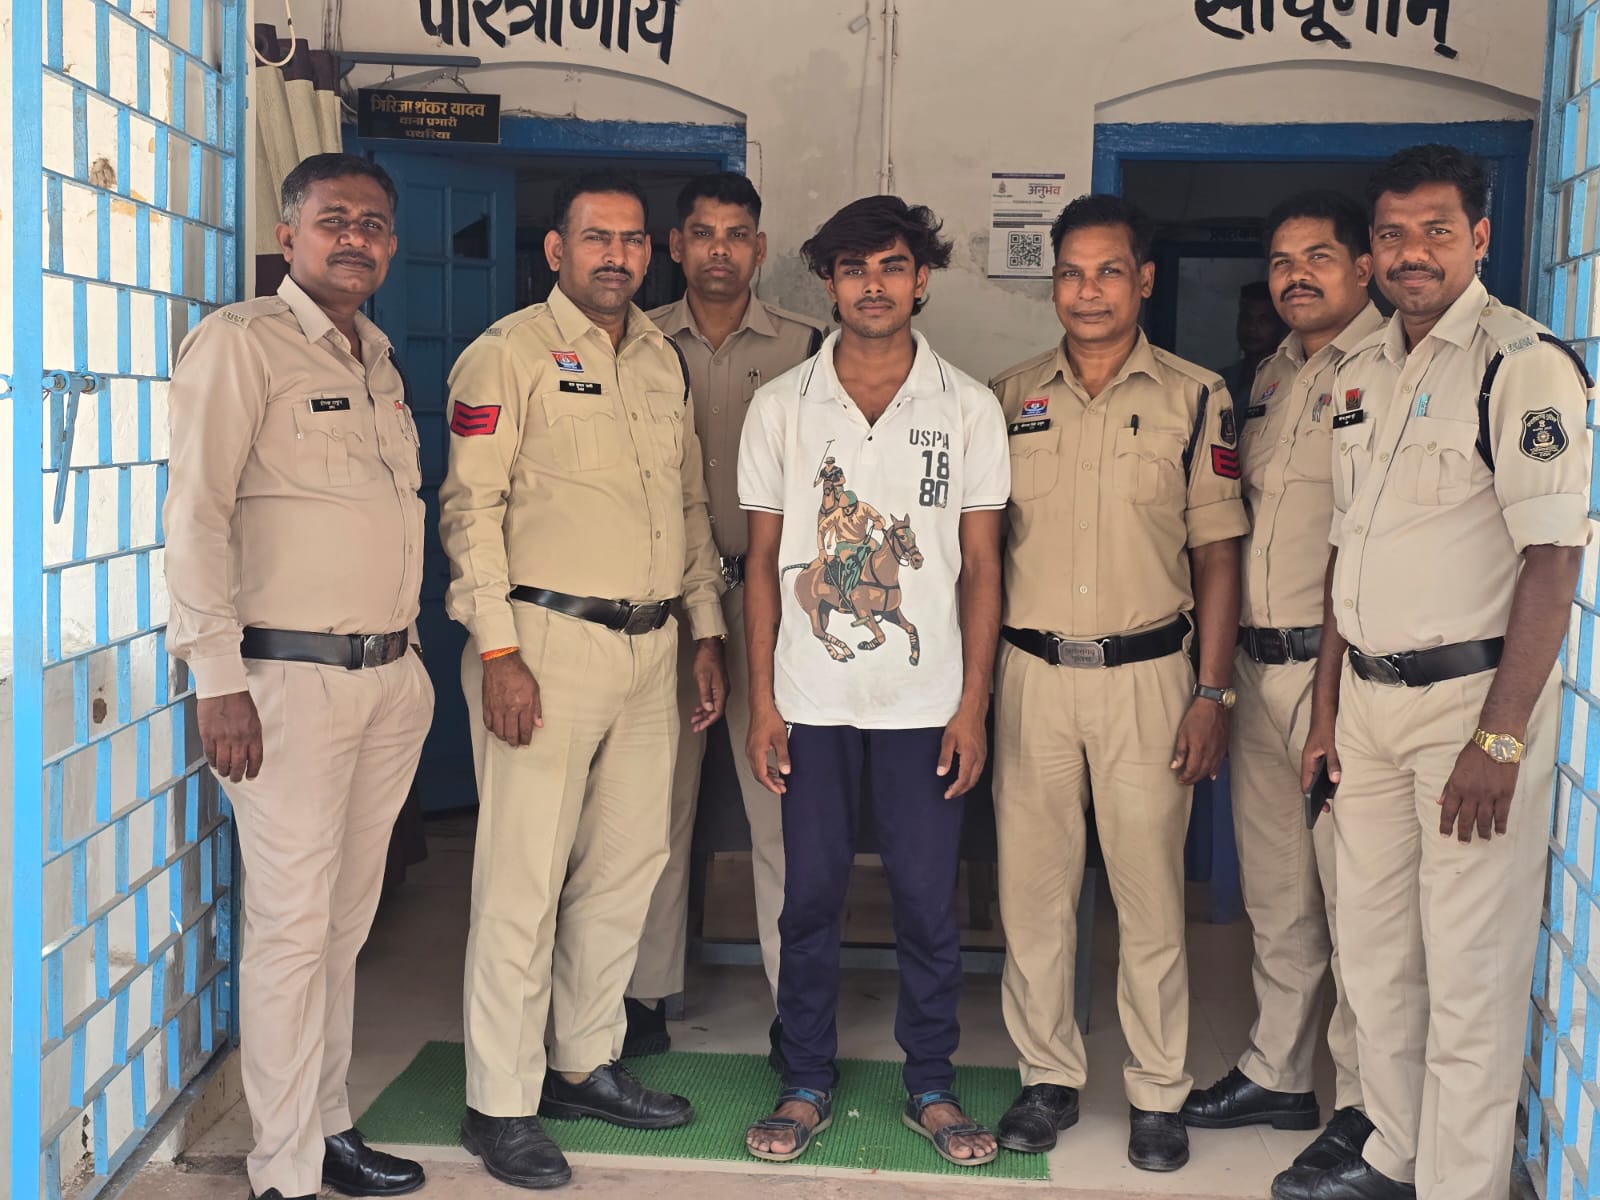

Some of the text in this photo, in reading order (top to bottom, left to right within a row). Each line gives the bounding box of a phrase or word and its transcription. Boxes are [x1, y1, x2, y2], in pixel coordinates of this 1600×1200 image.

[370, 94, 486, 118] गिरिजा शंकर यादव
[1027, 184, 1062, 199] अनुभव
[909, 428, 950, 450] USPA
[921, 450, 950, 480] 18
[919, 478, 949, 509] 80
